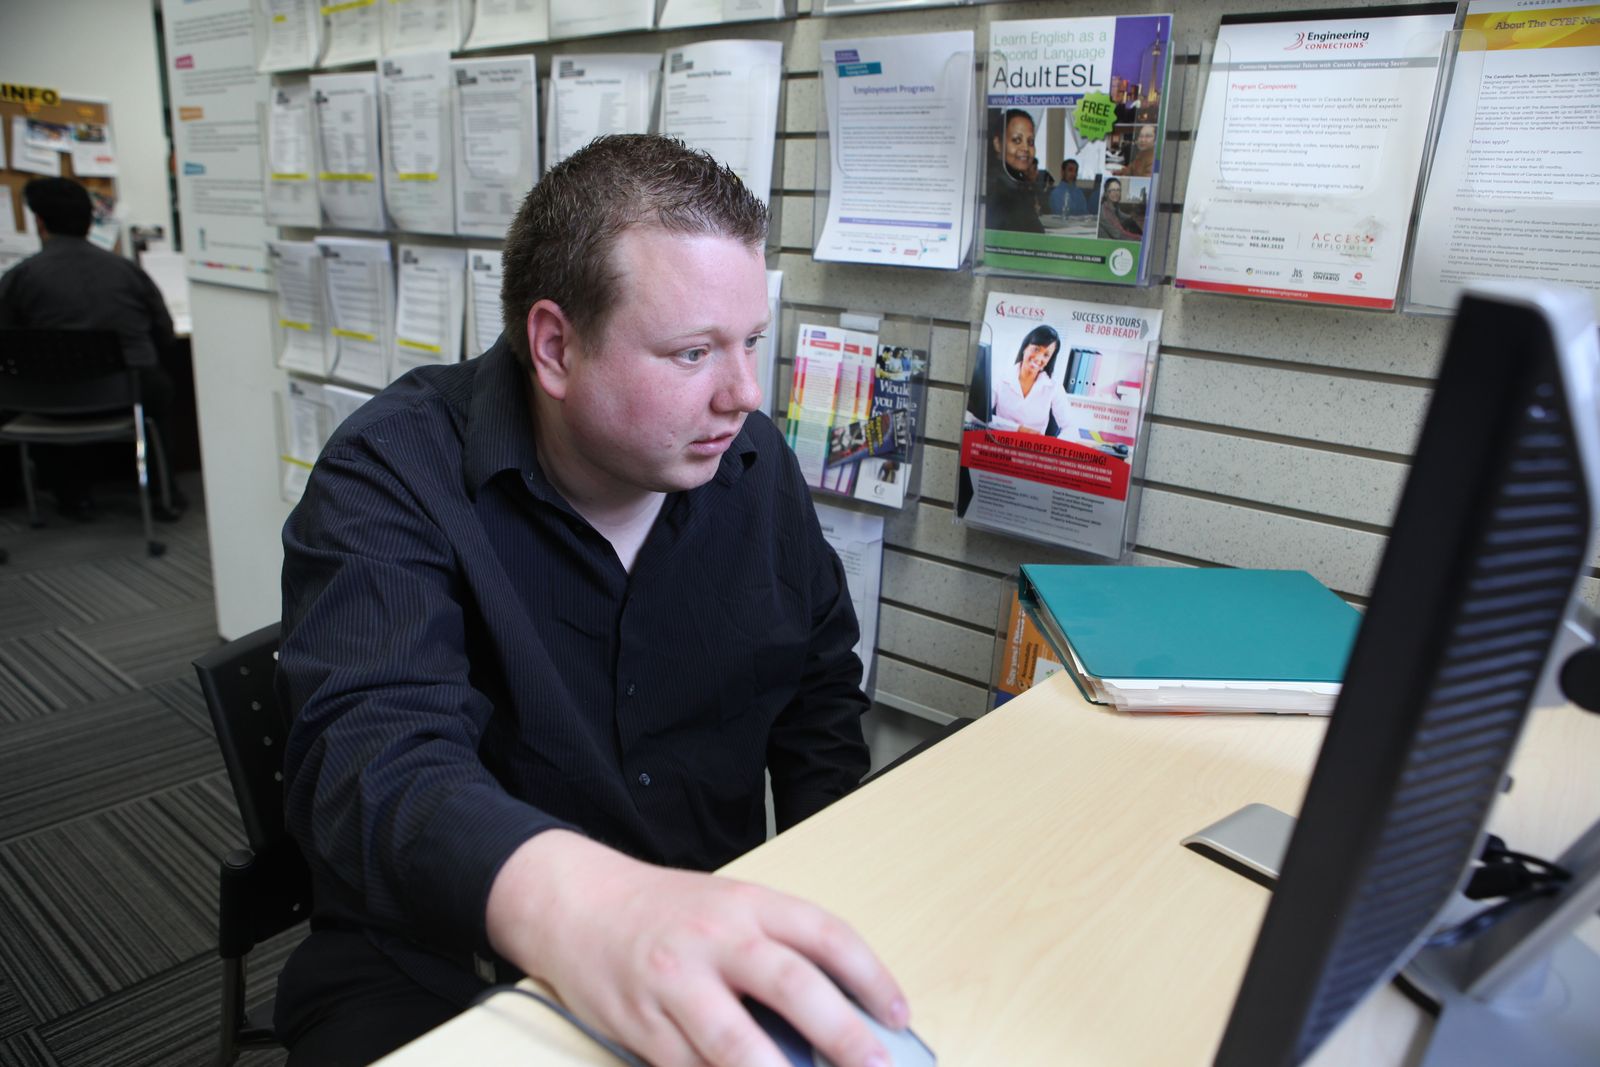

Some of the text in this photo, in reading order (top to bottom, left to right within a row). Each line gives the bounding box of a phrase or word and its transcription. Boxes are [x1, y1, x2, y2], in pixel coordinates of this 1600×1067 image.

[1495, 21, 1526, 30] About
[1528, 20, 1546, 28] The
[994, 31, 1107, 46] Learn English as a
[1307, 29, 1370, 42] Engineering
[1305, 42, 1365, 50] CONNECTIONS
[993, 47, 1106, 63] Second Language
[853, 84, 935, 95] Employment Programs
[1232, 82, 1297, 91] Program Components
[1, 83, 58, 105] INFO
[992, 95, 1074, 105] www.ESLtoronto.ca
[1082, 100, 1112, 118] FREE
[1080, 113, 1107, 126] classes
[1008, 305, 1045, 317] ACCESS
[1072, 312, 1142, 327] SUCCESS IS YOURS
[1085, 325, 1140, 337] BE JOB READY
[874, 395, 893, 411] you
[1108, 406, 1130, 414] PROVIDER
[1052, 446, 1067, 457] GET
[1068, 449, 1108, 466] FUNDING!
